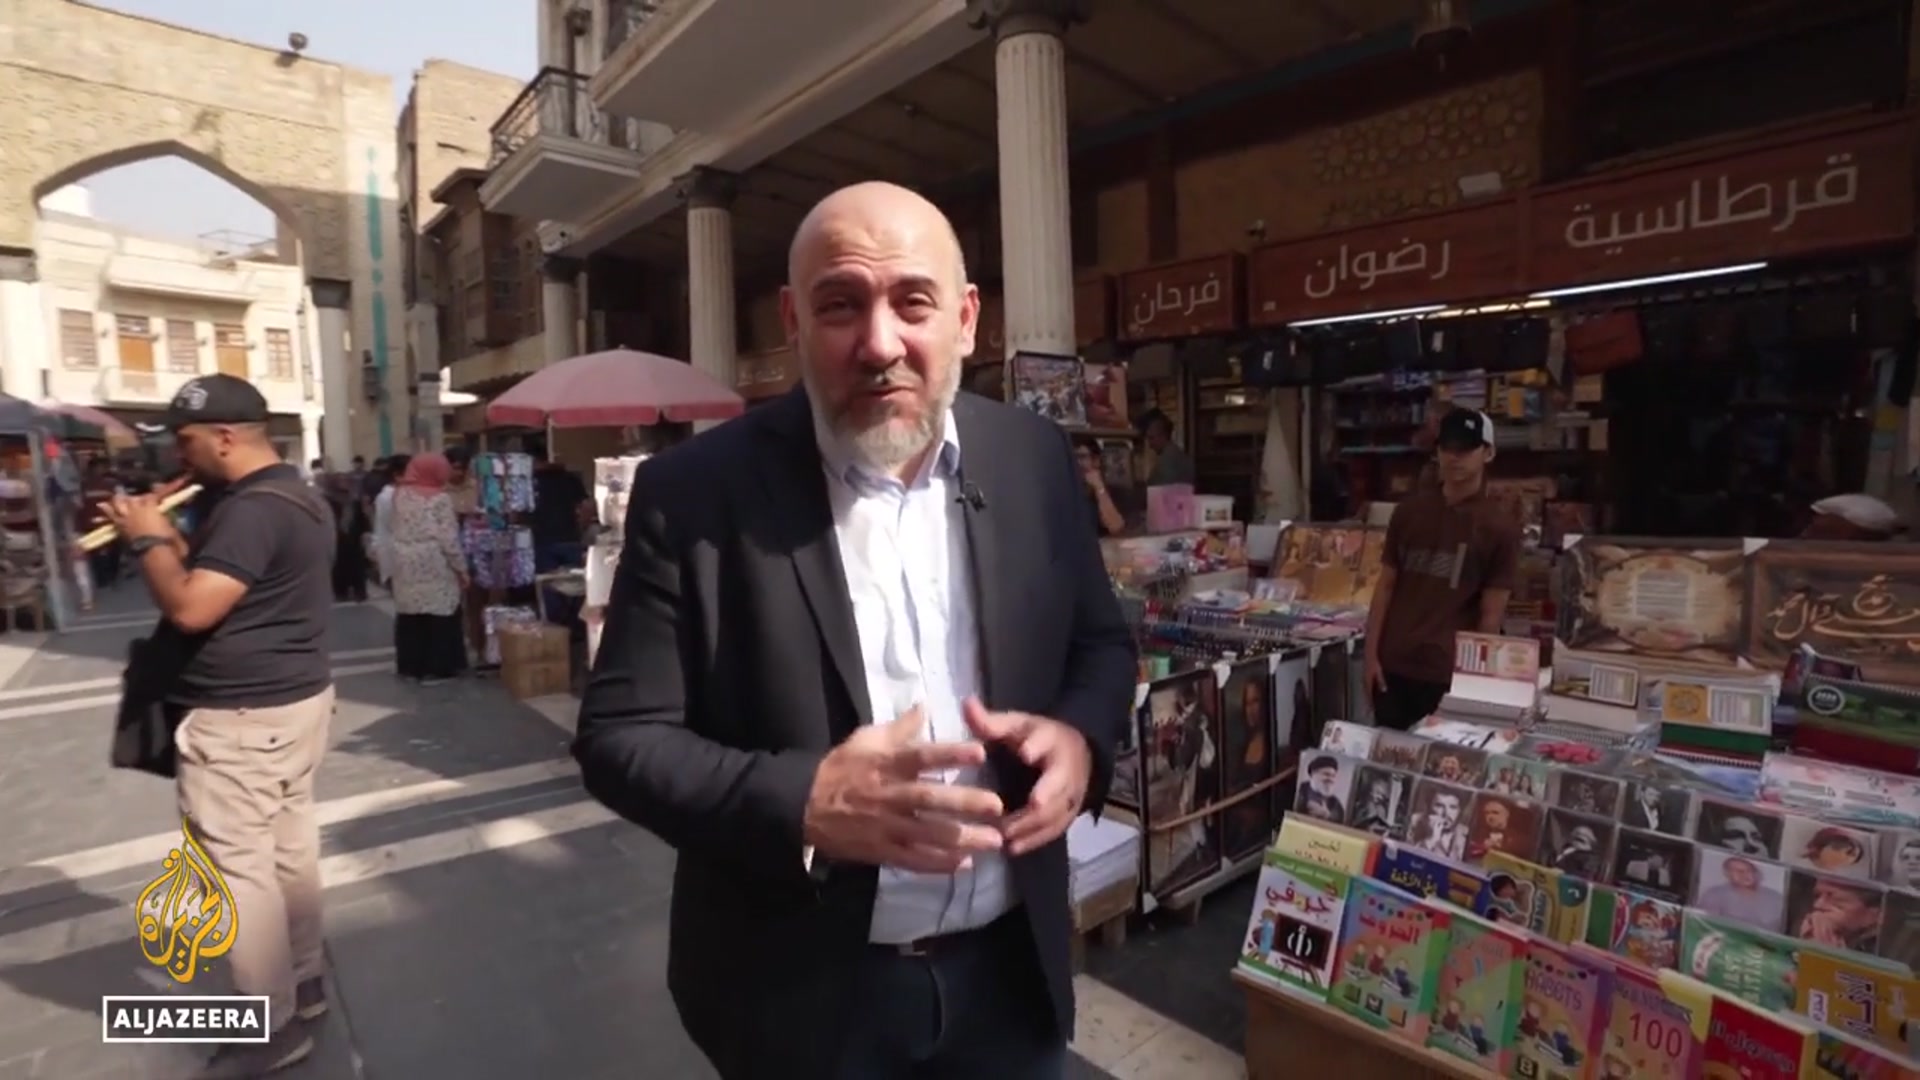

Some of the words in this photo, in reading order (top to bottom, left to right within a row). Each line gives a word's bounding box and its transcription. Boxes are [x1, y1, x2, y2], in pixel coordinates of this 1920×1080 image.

[1565, 152, 1860, 249] قرطاسية
[1303, 237, 1451, 299] رضوان
[1132, 270, 1222, 325] فرحان
[1629, 1012, 1683, 1058] 100
